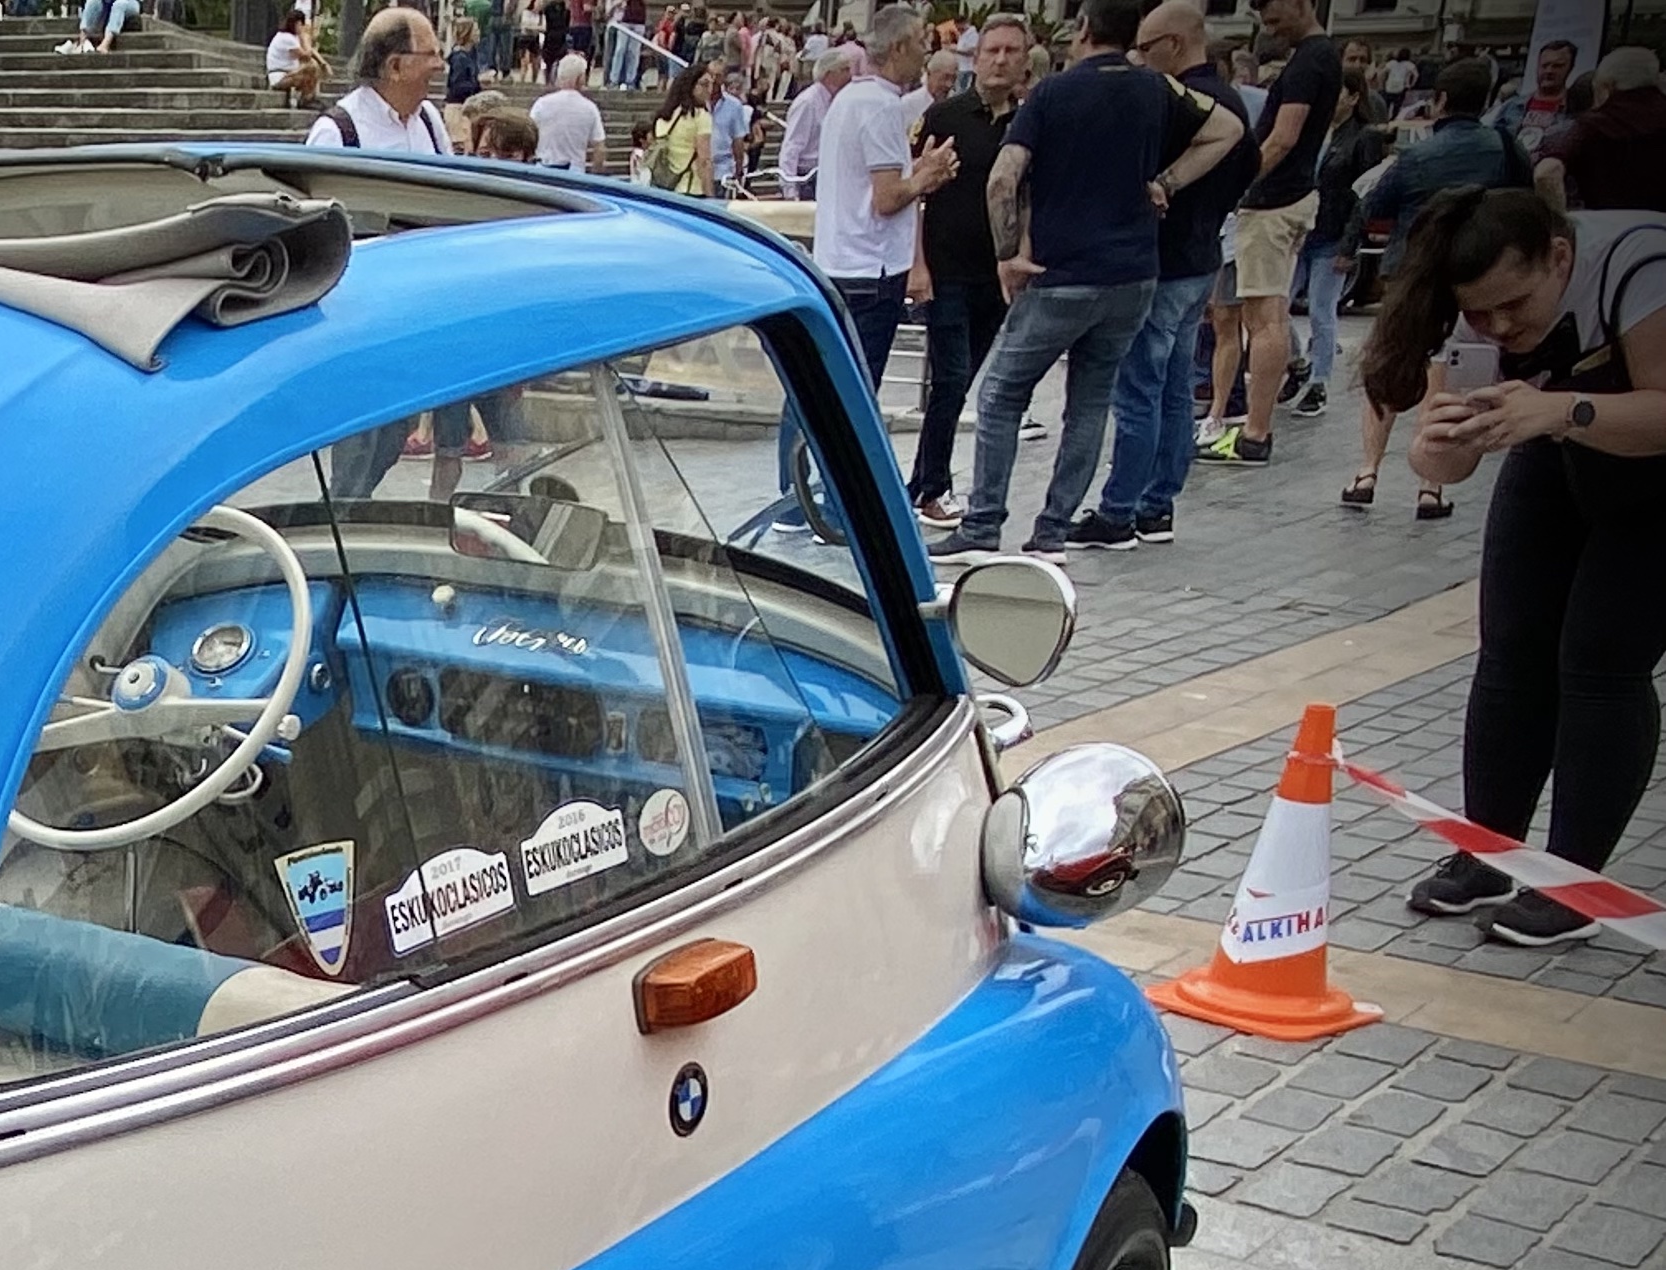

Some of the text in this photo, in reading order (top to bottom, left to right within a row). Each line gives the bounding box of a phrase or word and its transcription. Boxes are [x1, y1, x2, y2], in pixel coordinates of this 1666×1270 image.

[558, 809, 586, 829] 2016
[430, 856, 462, 879] 2017
[390, 862, 508, 934] ESKUKOCLASICOS
[1242, 905, 1329, 943] ALKIHA
